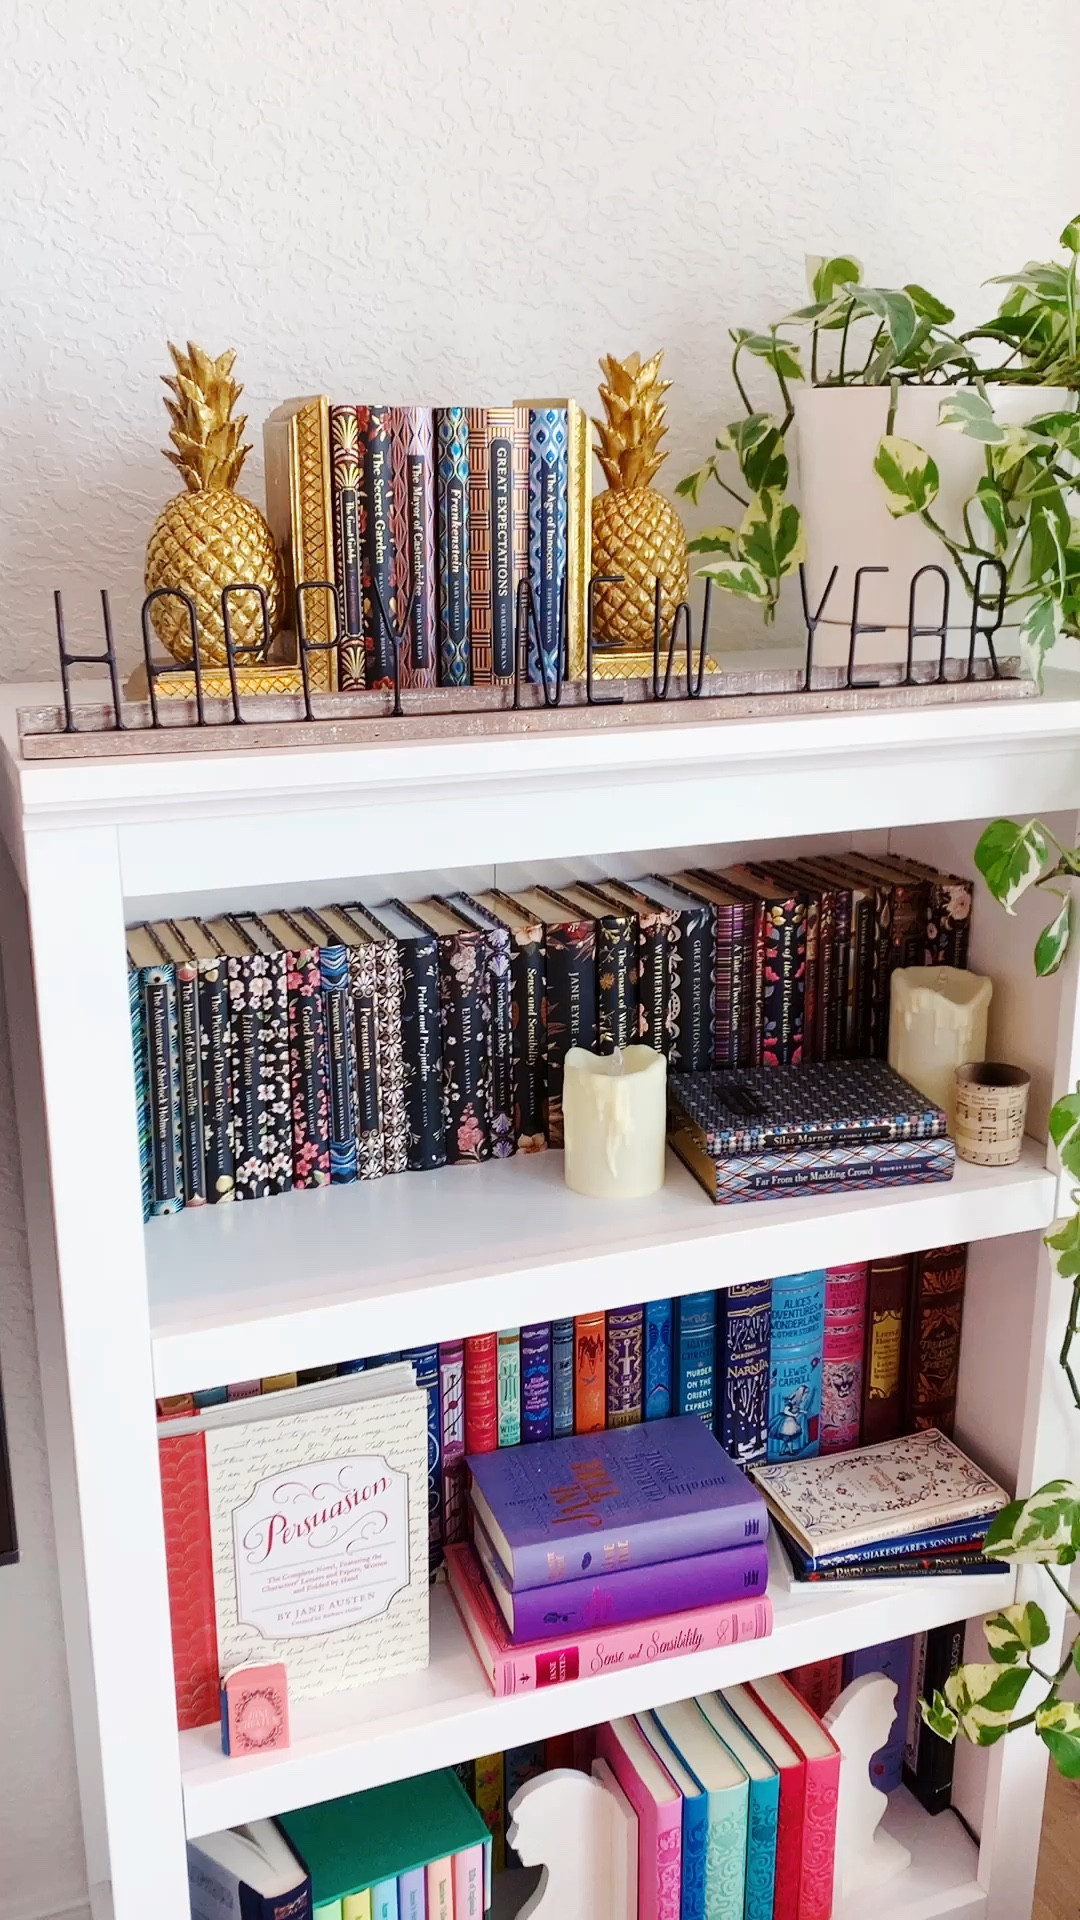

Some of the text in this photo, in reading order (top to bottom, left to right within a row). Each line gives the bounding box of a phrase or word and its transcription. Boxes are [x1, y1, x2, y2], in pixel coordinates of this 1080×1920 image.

[412, 463, 423, 483] The
[497, 447, 508, 493] GREAT
[546, 472, 557, 493] The
[373, 451, 387, 564] The Secret Garden
[410, 486, 424, 517] Mayor
[544, 494, 557, 514] Age
[413, 519, 424, 531] of
[450, 488, 464, 573] Frankenstein
[546, 516, 557, 528] of
[497, 497, 509, 597] EXPECTATIONS
[545, 529, 556, 580] Innocence
[412, 533, 425, 598] Casterbridge
[53, 577, 412, 733] HAPPY
[512, 575, 712, 710] NEW
[798, 560, 1008, 693] YEAR
[783, 925, 793, 946] Tess
[618, 949, 627, 966] The
[733, 953, 742, 972] Tale
[782, 947, 793, 959] of
[618, 968, 627, 997] Tenant
[653, 944, 663, 1014] WUTHERING
[733, 974, 742, 984] of
[755, 949, 765, 998] Christmas
[783, 961, 793, 977] the
[182, 983, 193, 1000] The
[417, 986, 428, 1013] Pride
[568, 972, 580, 1001] JANE
[692, 940, 702, 1054] GREAT EXPECTATIONS
[733, 987, 741, 1004] Two
[183, 1003, 194, 1034] Hound
[331, 991, 341, 1031] Treasure
[495, 982, 506, 1031] Northanger
[526, 968, 539, 1067] Sense and Sensibility
[618, 999, 627, 1010] of
[732, 1005, 740, 1031] Cities
[755, 1000, 764, 1027] Carol
[782, 979, 793, 1044] D'Urbervilles
[242, 1014, 253, 1043] Little
[302, 1006, 313, 1035] Good
[419, 1015, 429, 1034] and
[462, 1007, 472, 1044] EMMA
[570, 1005, 580, 1035] EYRE
[184, 1036, 196, 1046] of
[334, 1033, 344, 1060] Island
[360, 1007, 372, 1070] Persuasion
[496, 1032, 507, 1058] Abbey
[152, 989, 169, 1138] The Adventures of Sherlock Holmes
[185, 1047, 195, 1061] the
[210, 993, 226, 1122] The Picture of Dorian Gray
[243, 1046, 255, 1086] Women
[303, 1037, 315, 1070] Wives
[417, 1036, 430, 1082] Prejudice
[185, 1064, 197, 1116] Baskervilles
[773, 1134, 834, 1145] Silas Marner
[755, 1177, 769, 1187] Far
[771, 1176, 793, 1185] From
[795, 1173, 808, 1182] the
[810, 1170, 845, 1182] Madding
[847, 1165, 874, 1177] Crowd
[686, 1366, 712, 1378] MURDER
[687, 1377, 712, 1389] ON THE
[726, 1359, 768, 1379] NARNIA
[783, 1365, 808, 1378] LEWIS
[685, 1399, 713, 1412] EXPRESS
[687, 1388, 712, 1401] ORIENT
[244, 1476, 392, 1564] Persuasion
[862, 1542, 928, 1560] SHAKESPEARE'S
[929, 1534, 968, 1549] SONNETS
[277, 1610, 291, 1622] BY
[295, 1603, 325, 1619] JANE
[329, 1592, 376, 1610] AUSTEN
[590, 1642, 624, 1674] Sense
[628, 1643, 643, 1660] and
[647, 1626, 705, 1660] Sensibility
[549, 1660, 557, 1681] JANE
